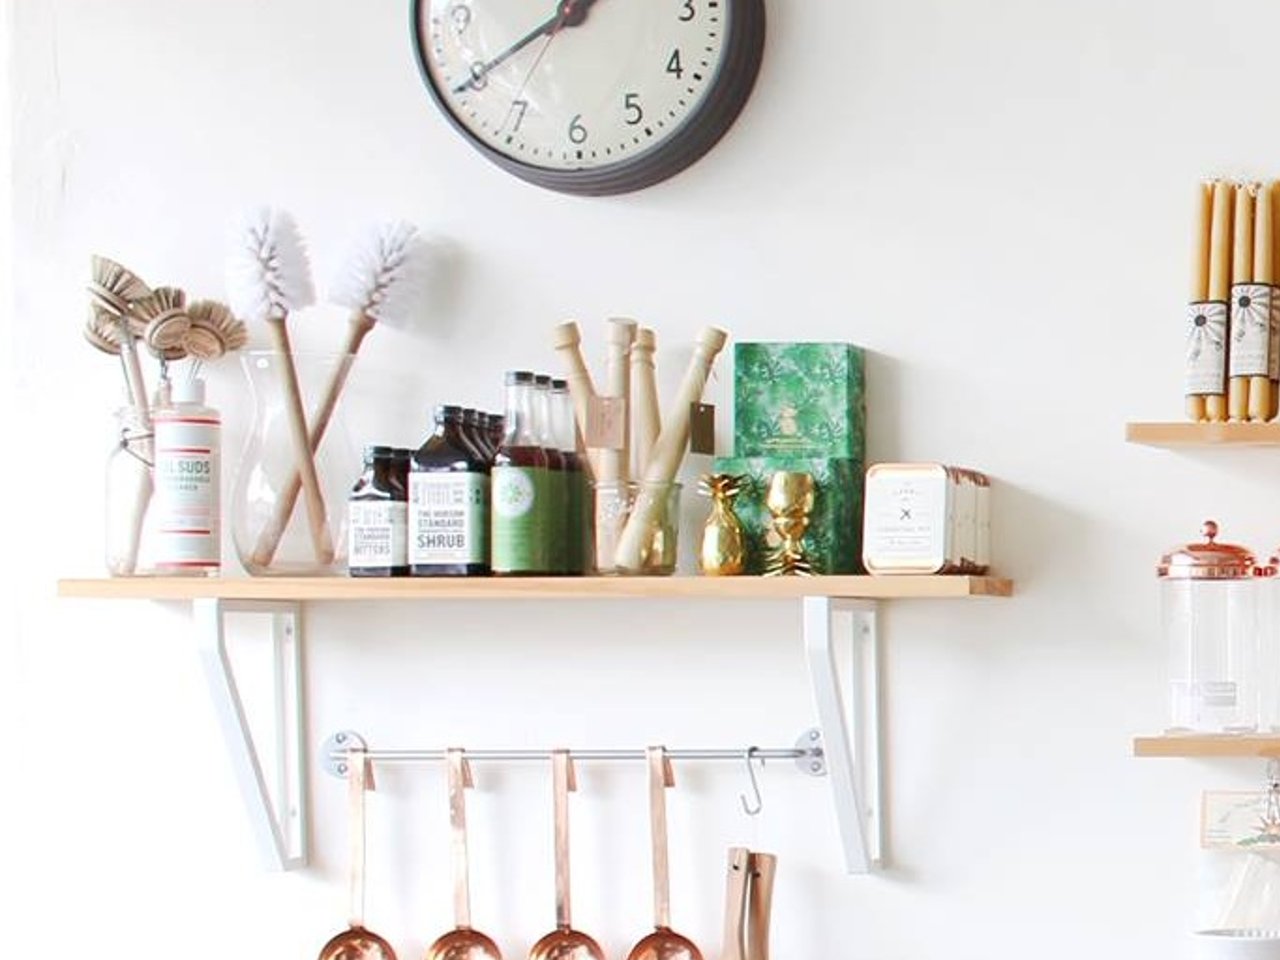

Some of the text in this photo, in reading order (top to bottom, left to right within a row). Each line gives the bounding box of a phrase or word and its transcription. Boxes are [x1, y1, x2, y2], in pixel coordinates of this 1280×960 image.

[452, 5, 471, 34] 9
[679, 0, 695, 22] 3
[666, 49, 683, 79] 4
[513, 100, 528, 132] 7
[624, 93, 643, 124] 5
[568, 114, 587, 144] 6
[417, 534, 466, 549] SHRUB
